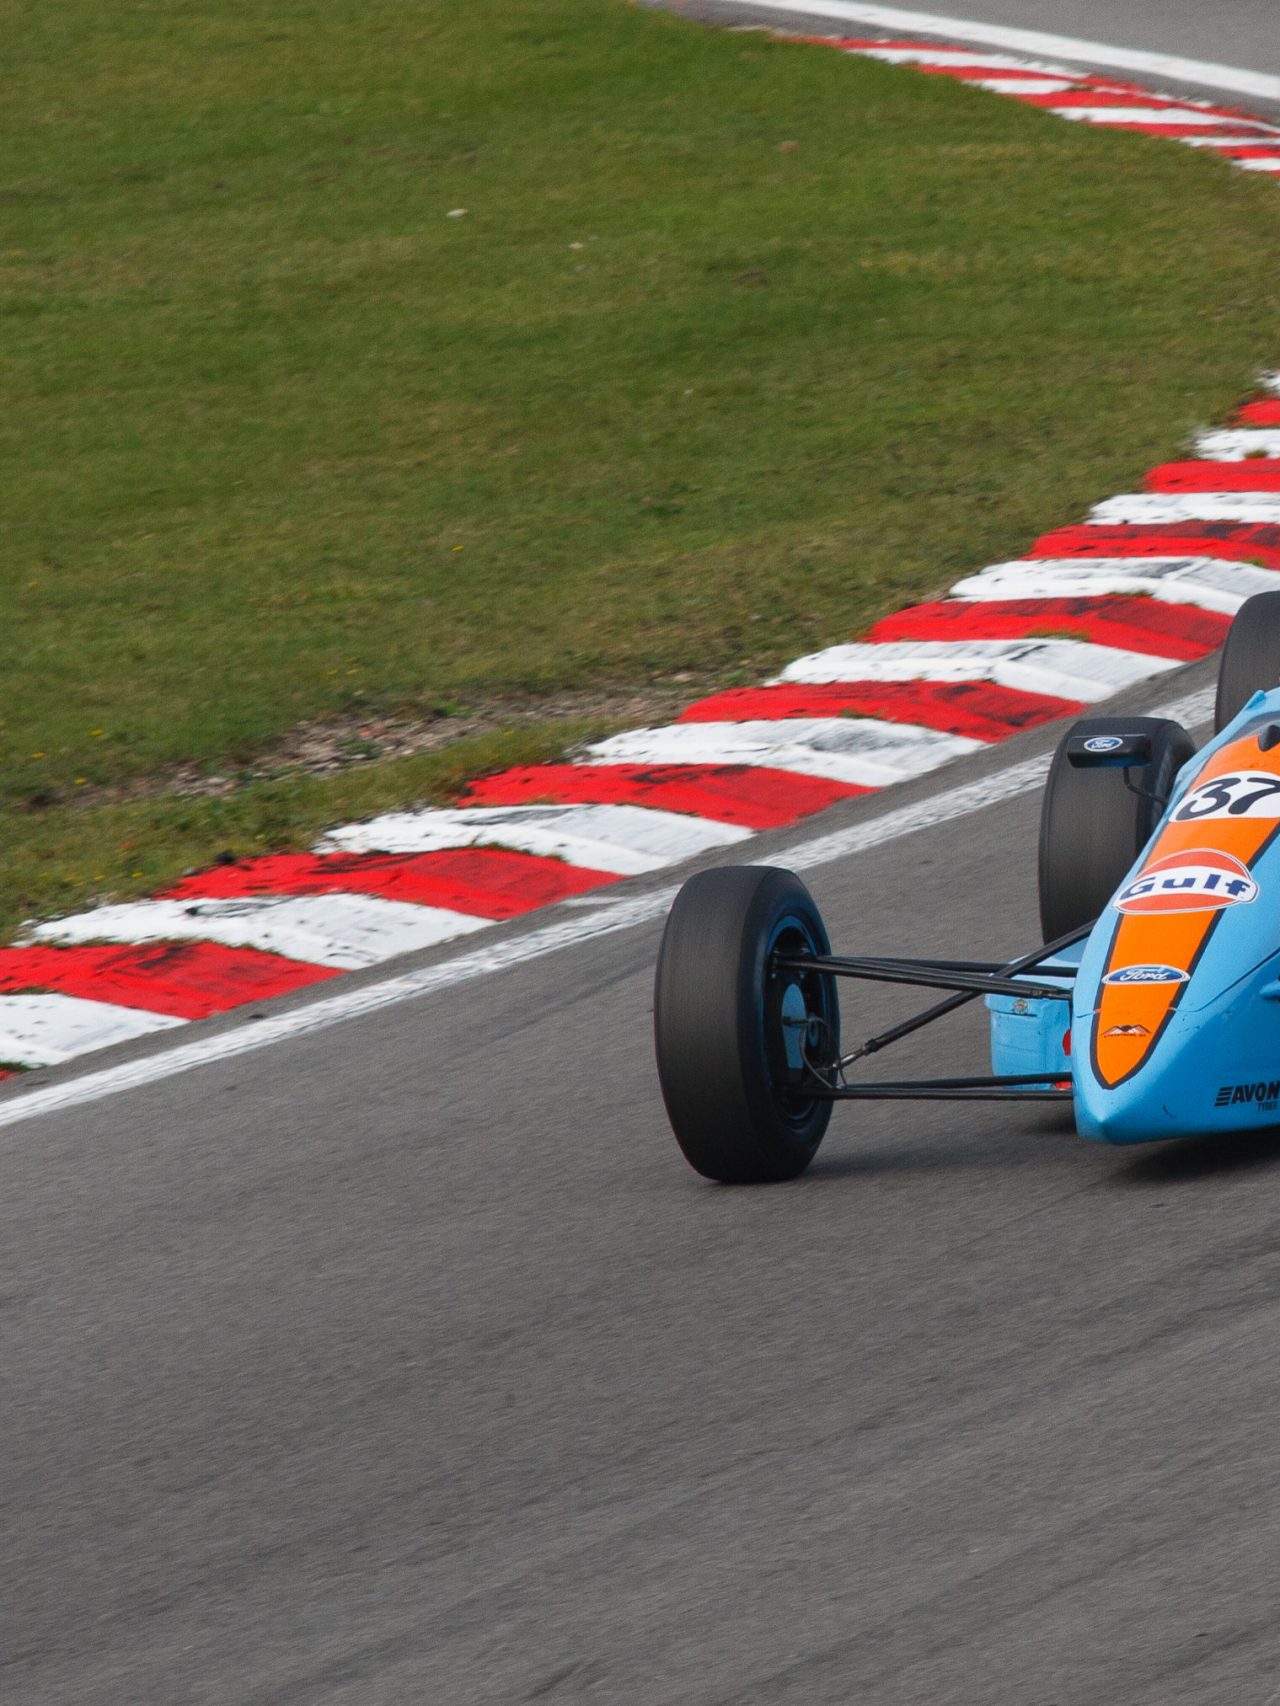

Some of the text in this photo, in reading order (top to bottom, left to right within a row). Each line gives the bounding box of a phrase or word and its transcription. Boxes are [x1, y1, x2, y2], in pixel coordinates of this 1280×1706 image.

[1119, 873, 1250, 901] Gulf
[1119, 967, 1168, 981] Ford
[1231, 1081, 1280, 1104] AVON
